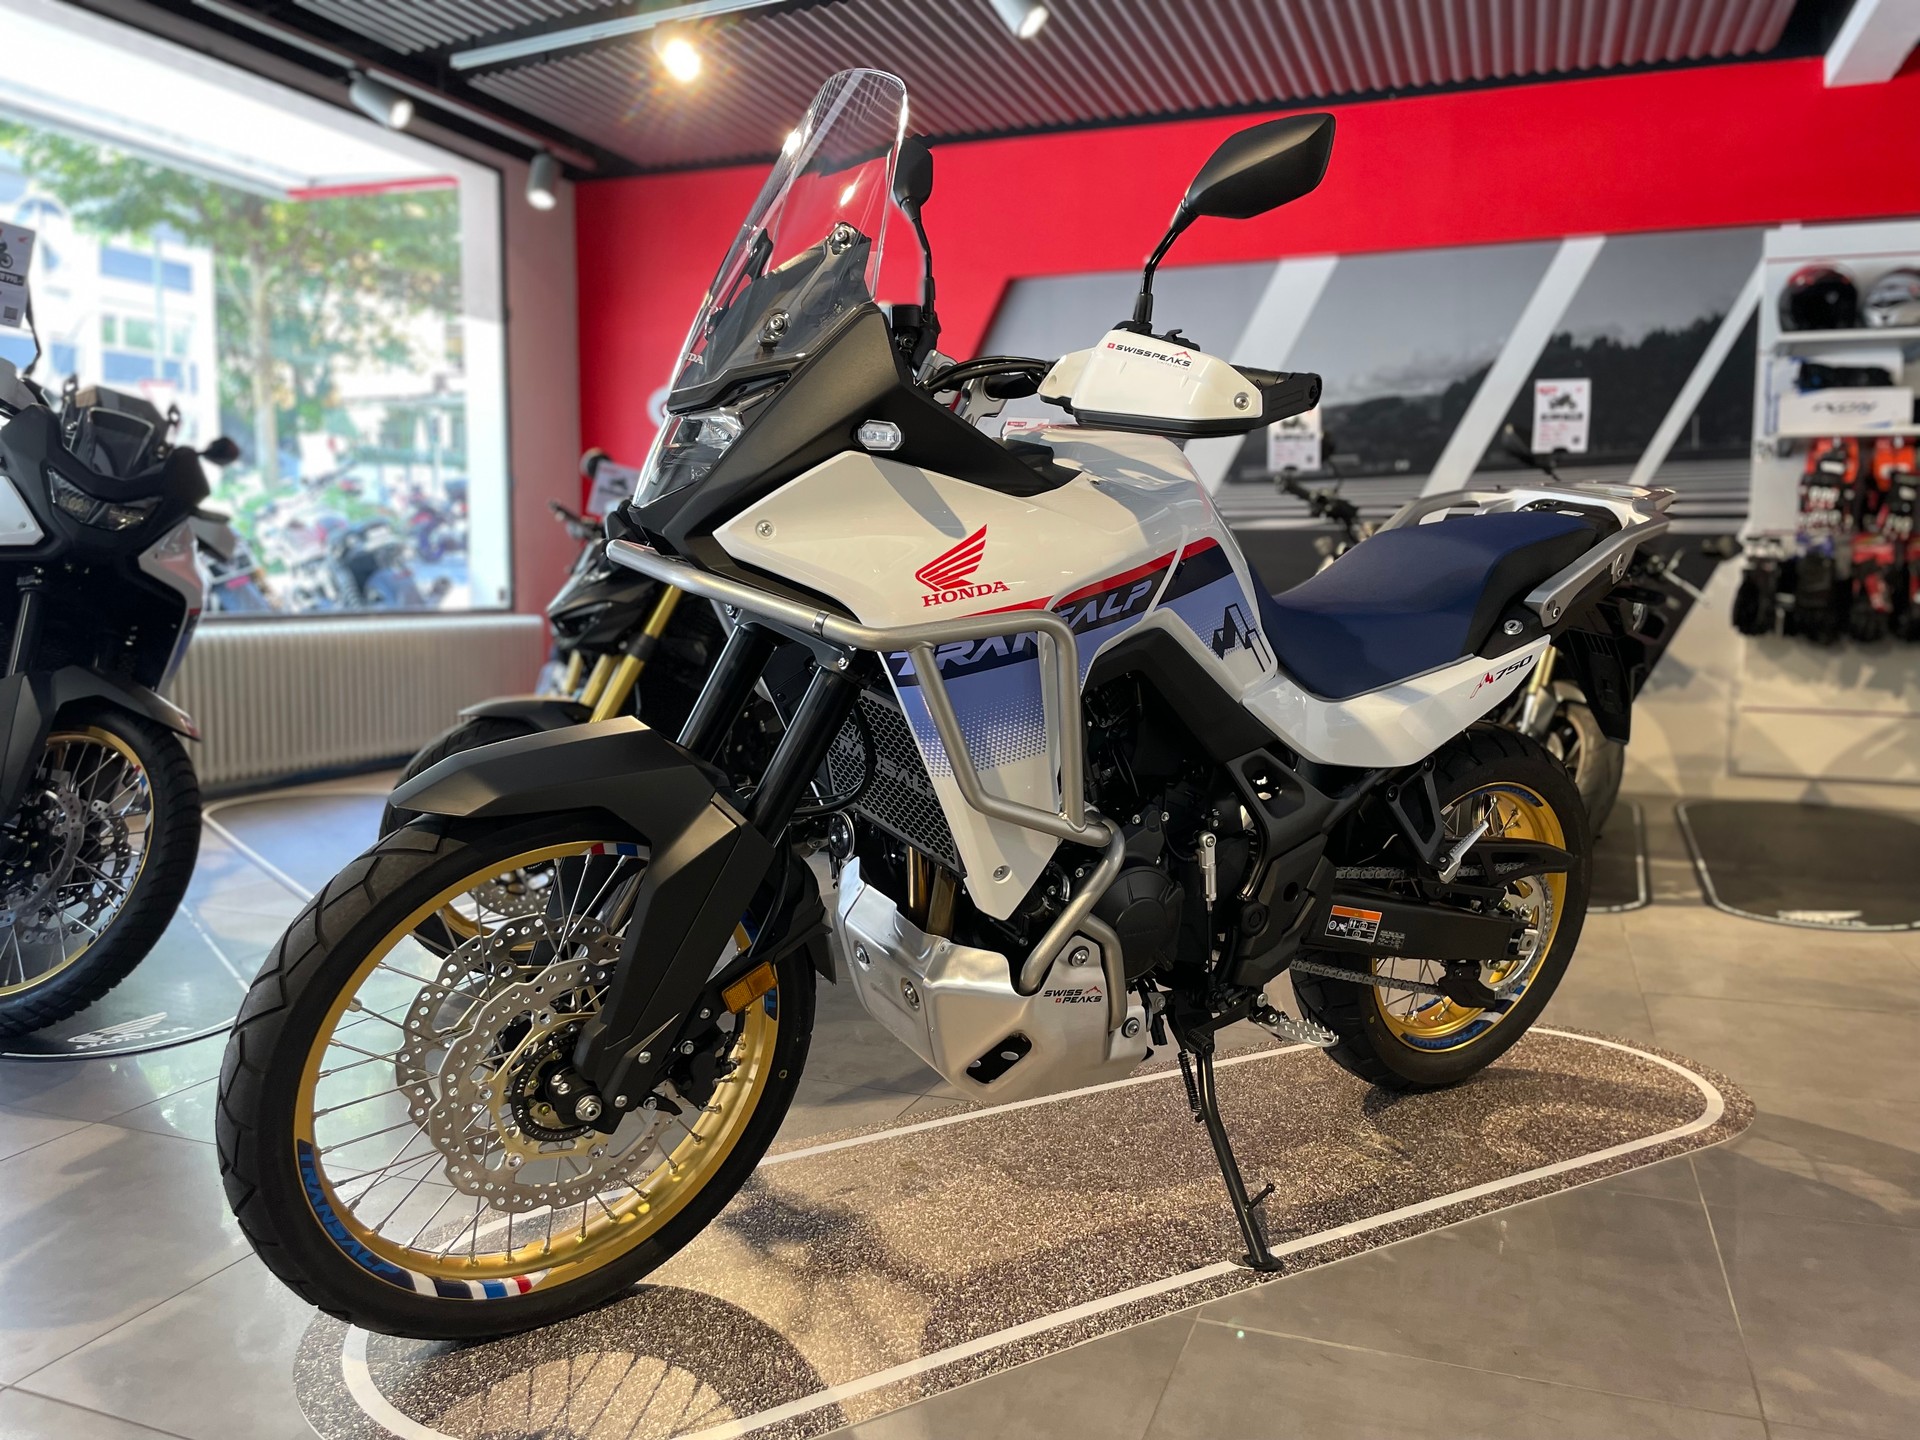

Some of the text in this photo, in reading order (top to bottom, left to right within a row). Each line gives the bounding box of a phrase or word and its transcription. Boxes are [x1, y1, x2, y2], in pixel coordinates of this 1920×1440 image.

[921, 581, 1011, 607] HONDA
[1495, 654, 1533, 681] 750
[1043, 989, 1084, 997] SWISS
[1062, 995, 1103, 1004] PEAKS
[300, 1153, 401, 1274] TRANSALP
